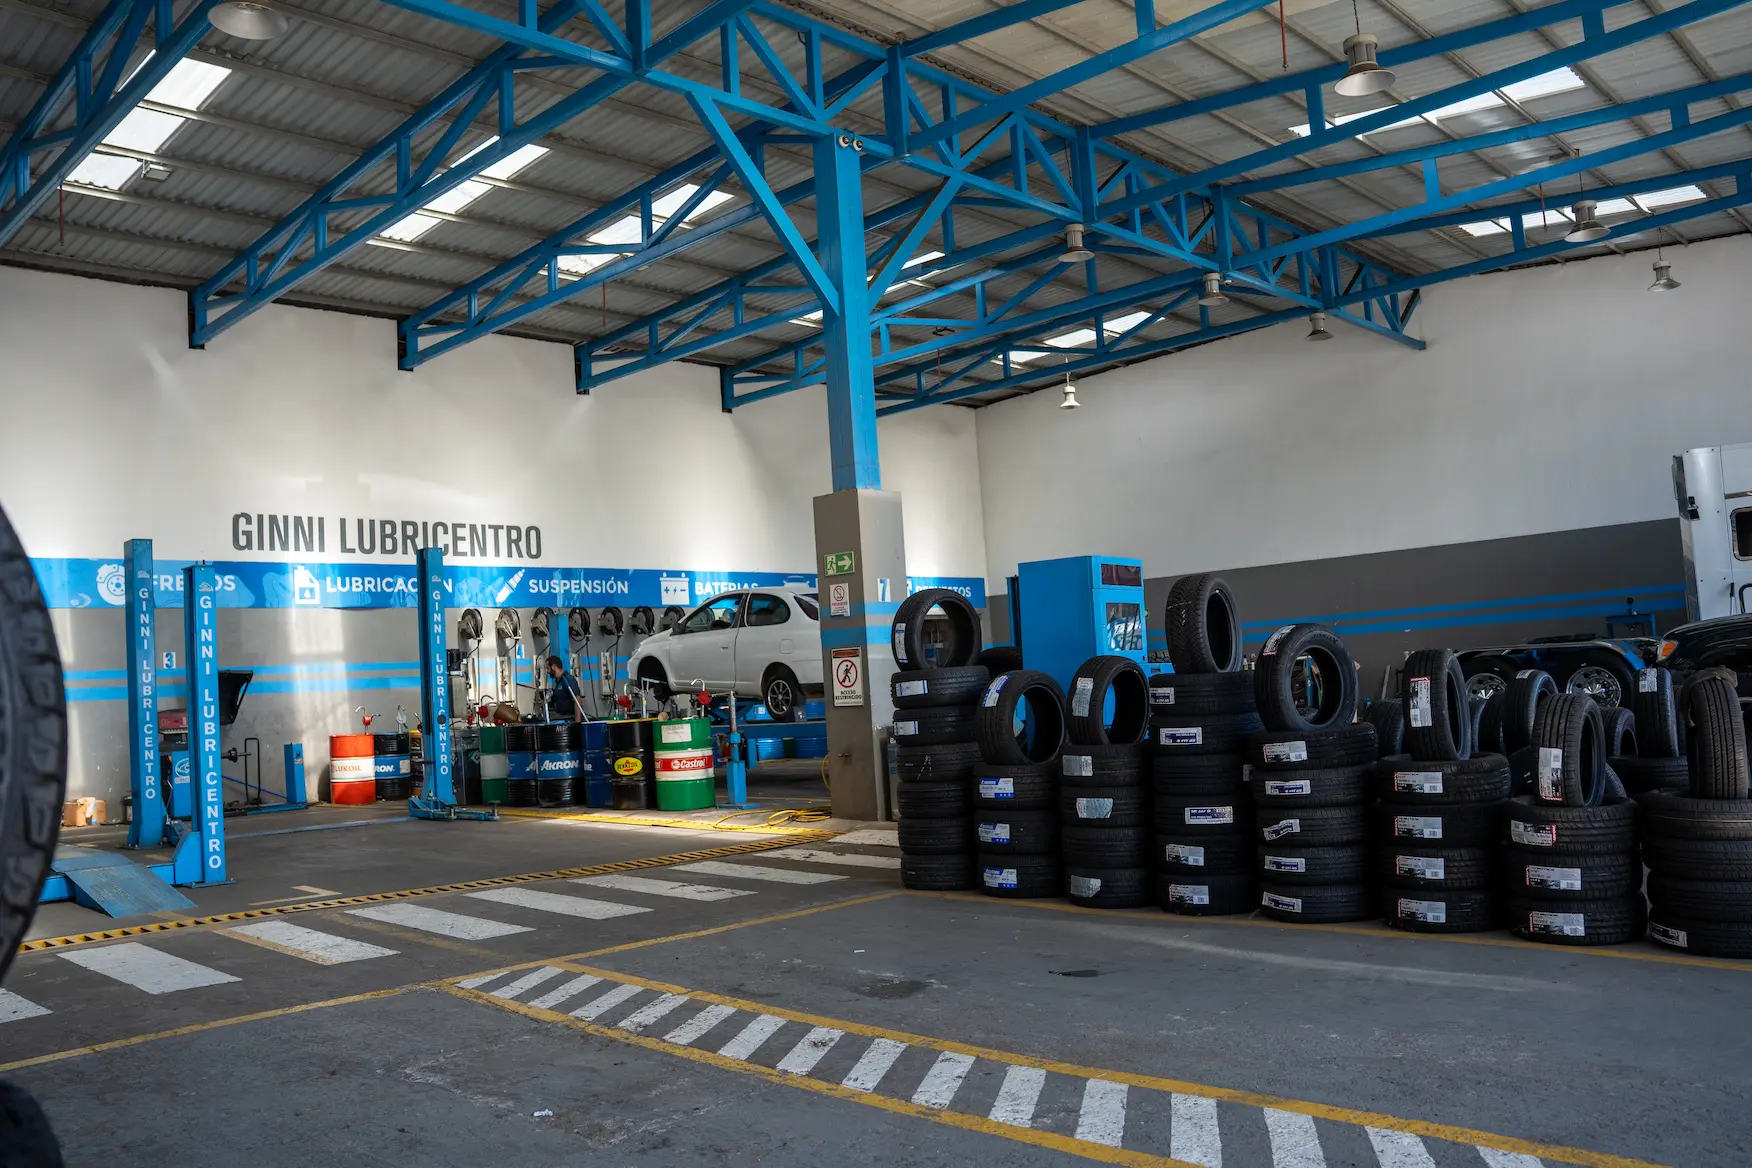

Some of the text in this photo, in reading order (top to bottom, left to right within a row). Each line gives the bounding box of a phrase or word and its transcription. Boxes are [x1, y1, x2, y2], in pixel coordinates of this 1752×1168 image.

[232, 512, 542, 560] GINNI LUBRICENTRO
[326, 577, 453, 593] LUBRICACN
[528, 576, 629, 595] SUSPENSIÓN
[880, 579, 888, 602] 7
[432, 590, 441, 645] GINNI
[165, 652, 175, 669] 3
[139, 588, 156, 799] GINNI LUBRICENTRO
[200, 595, 222, 869] GINNI LUBRICENTRO
[541, 760, 579, 771] AKRON
[680, 758, 706, 769] Castrol
